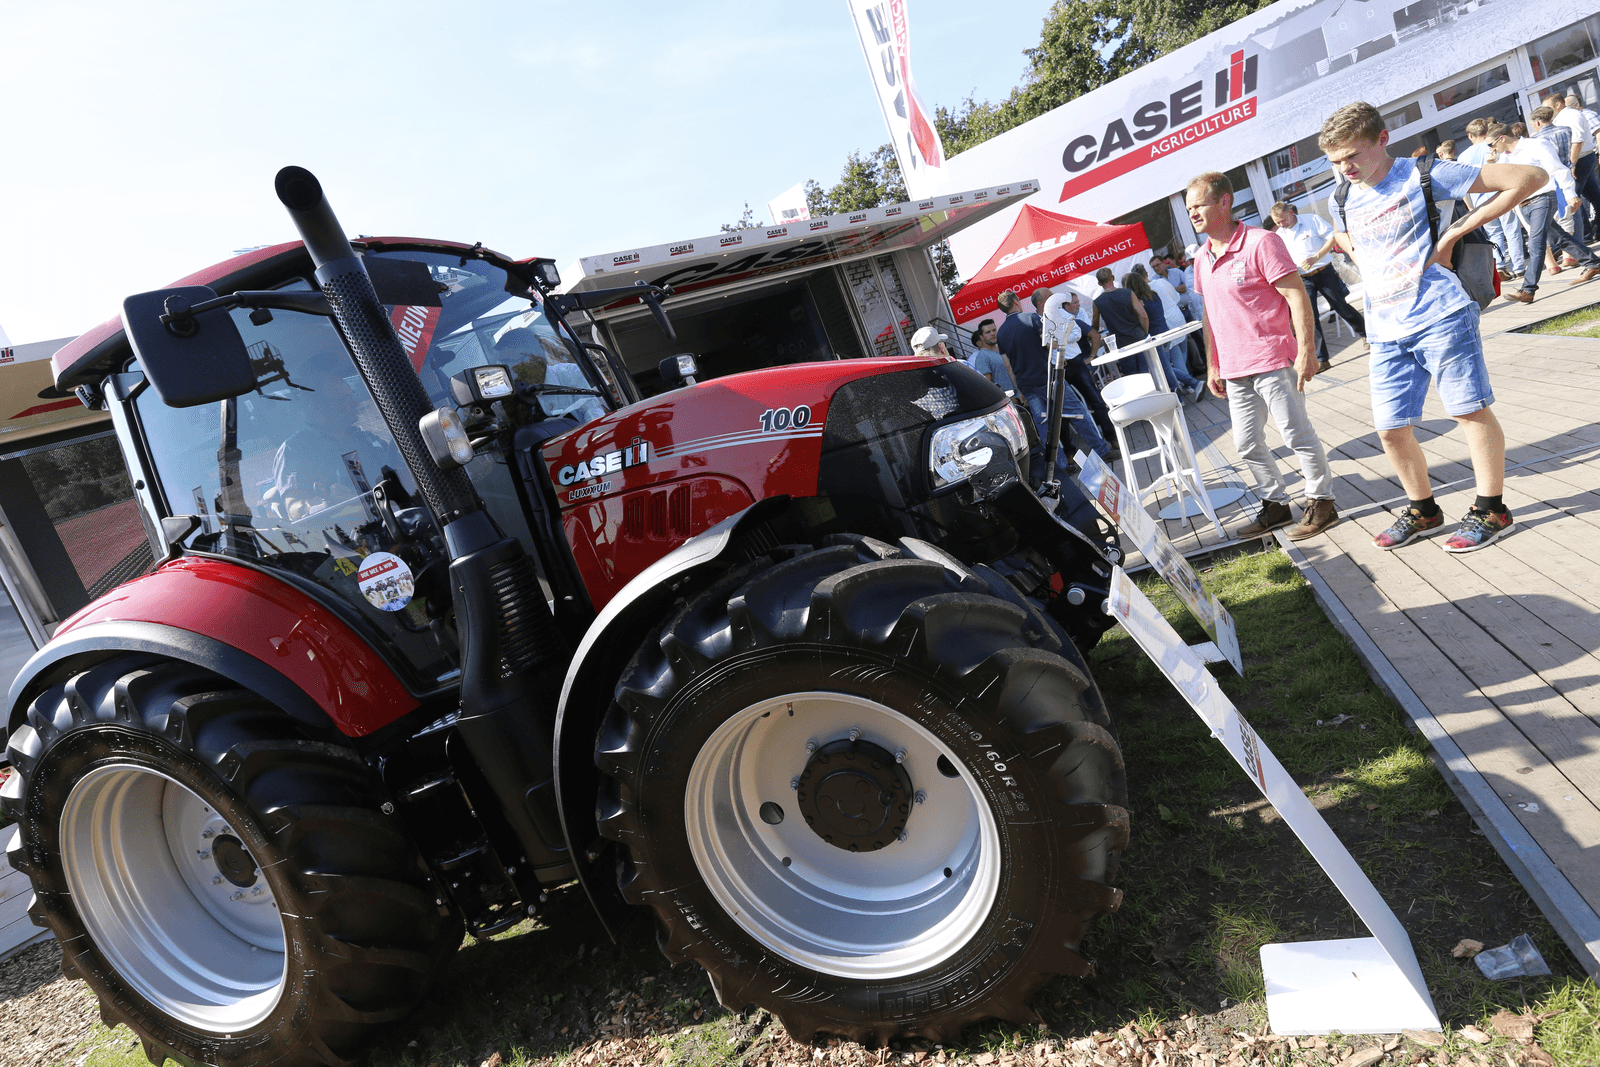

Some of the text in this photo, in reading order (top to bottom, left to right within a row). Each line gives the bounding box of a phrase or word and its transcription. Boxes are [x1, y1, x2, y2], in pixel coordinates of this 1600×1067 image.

[1062, 49, 1258, 173] CASE IH
[1150, 102, 1252, 158] AGRICULTURE
[613, 255, 633, 263] CASE
[670, 245, 688, 253] CASE
[998, 238, 1056, 264] CASE
[957, 238, 1135, 316] CASE IH. OOR WIE MEER VERLANGT.
[759, 404, 811, 433] 100
[558, 436, 649, 486] CASE IH
[568, 481, 612, 501] LUXXUM
[1239, 722, 1258, 778] CASE
